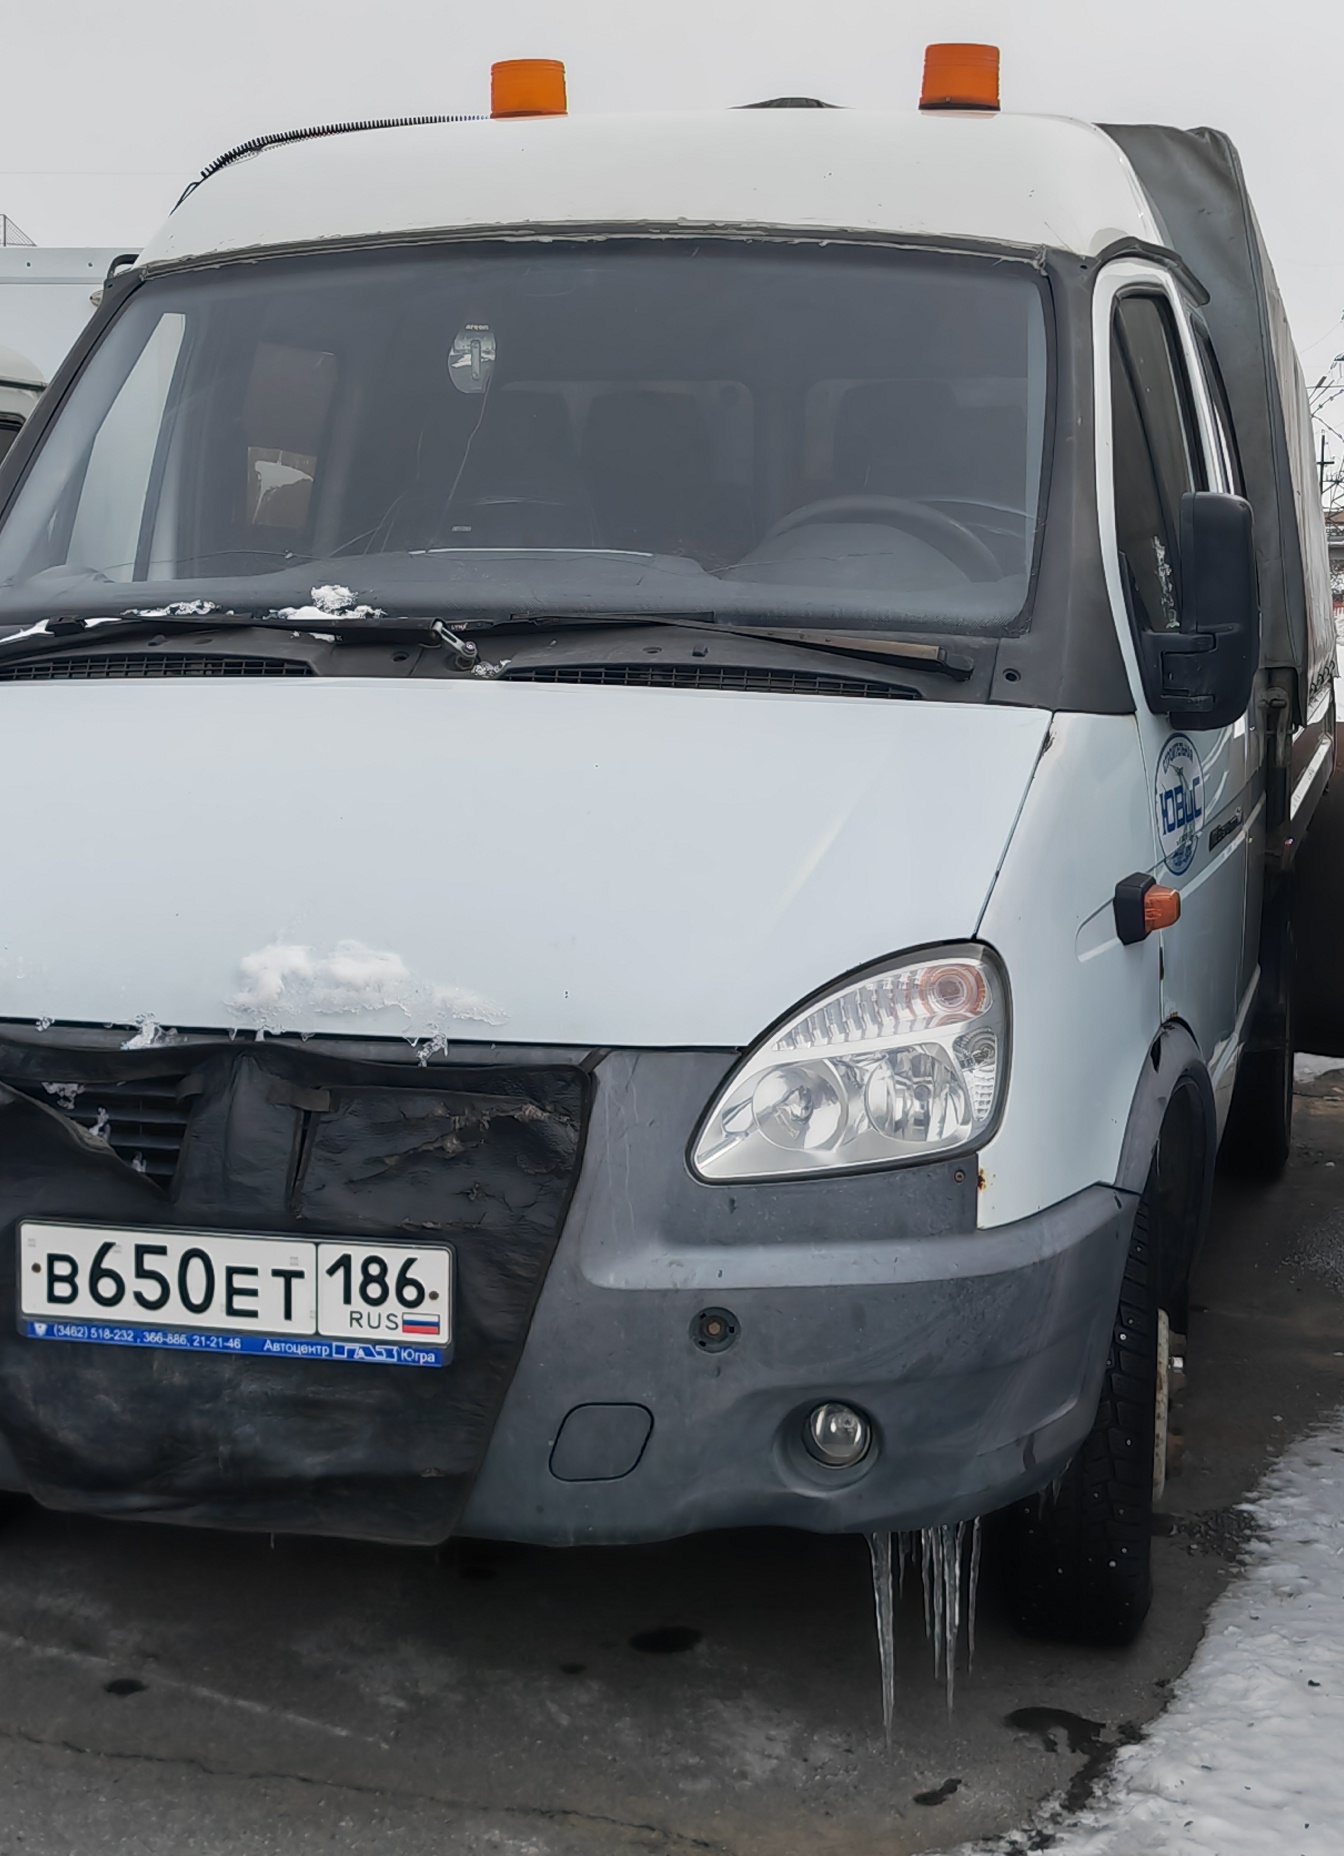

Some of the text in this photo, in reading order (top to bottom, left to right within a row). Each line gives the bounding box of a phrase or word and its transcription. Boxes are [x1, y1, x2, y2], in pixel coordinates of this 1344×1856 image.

[325, 1252, 426, 1309] 186
[349, 1311, 400, 1331] RUS
[53, 1324, 89, 1339] (3462)
[263, 1338, 331, 1358] Автоцентр
[401, 1349, 436, 1365] Югра
